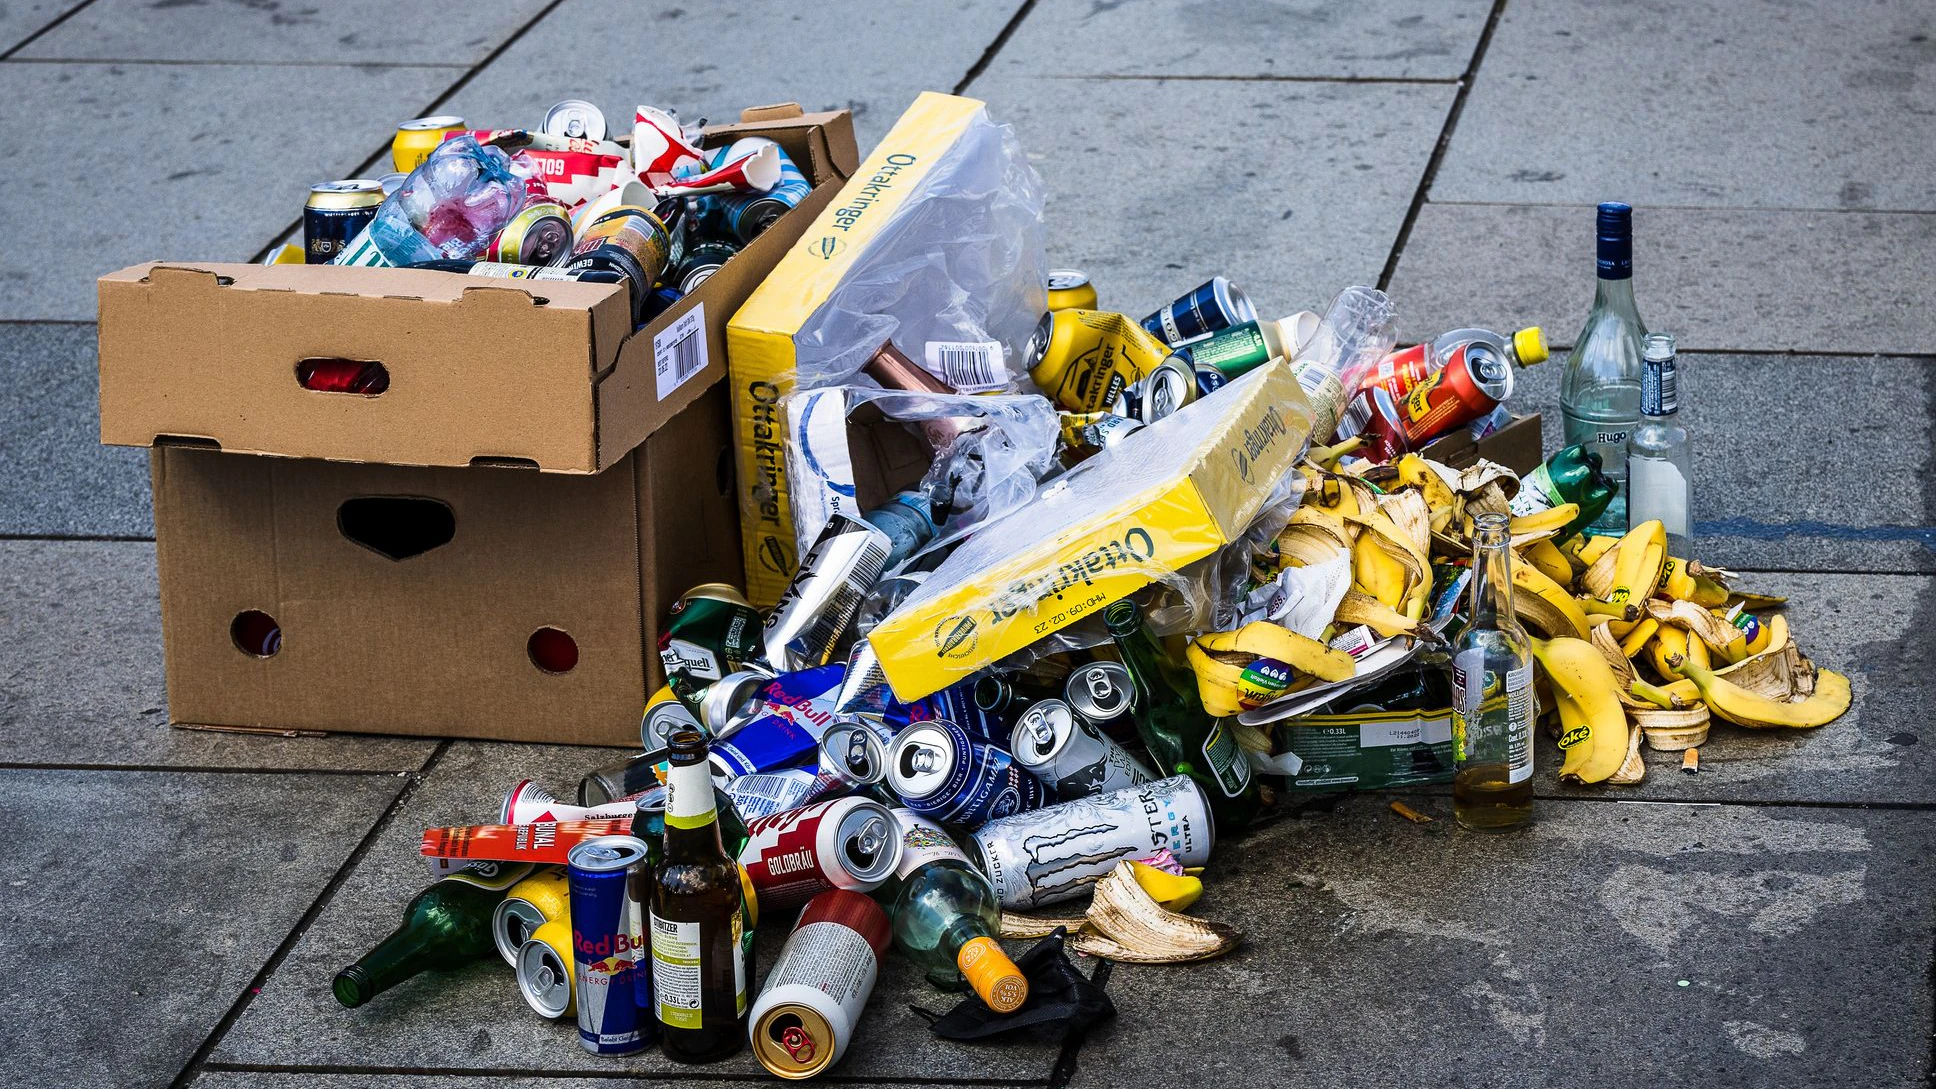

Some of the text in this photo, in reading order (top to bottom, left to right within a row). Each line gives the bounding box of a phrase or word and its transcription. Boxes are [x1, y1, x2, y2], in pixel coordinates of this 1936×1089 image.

[831, 153, 917, 232] Ottakringer
[1105, 375, 1122, 405] HELLES
[1249, 405, 1286, 463] Ottakringer
[1598, 430, 1627, 444] Hugo
[748, 381, 784, 527] Ottakringer
[992, 526, 1155, 626] Ottakringer
[763, 681, 833, 727] Red Bull
[771, 719, 797, 740] DRINK
[952, 724, 967, 765] PUNTIGAMER
[1561, 725, 1591, 747] oké
[952, 772, 964, 789] BIER
[953, 756, 1001, 824] PUNTIGAMER
[1182, 815, 1193, 853] ULTRA
[767, 846, 815, 876] GOLDBRÄU
[987, 841, 1004, 884] ZUCKER
[573, 928, 610, 955] Red
